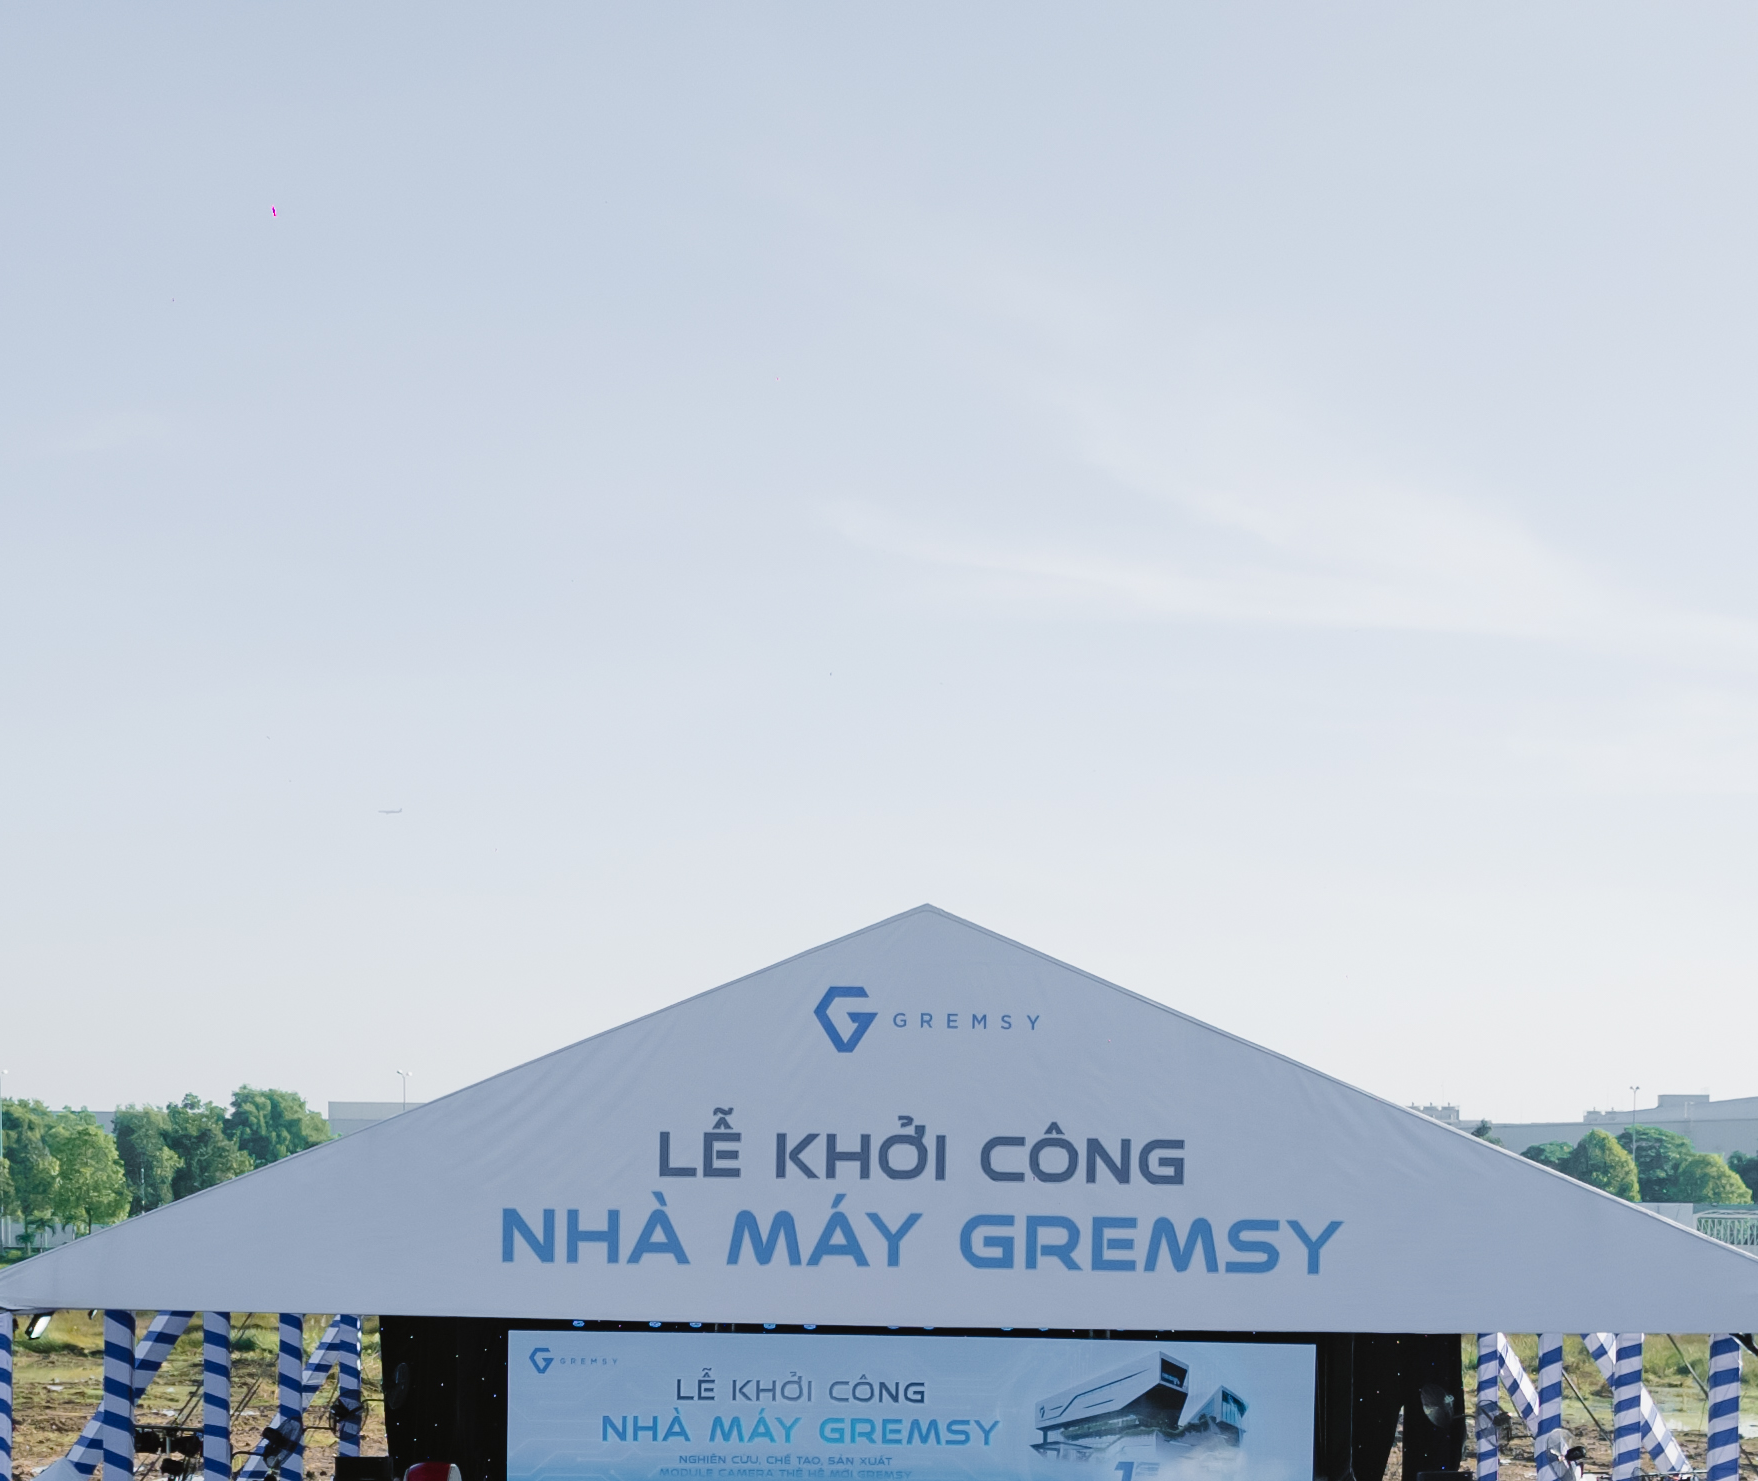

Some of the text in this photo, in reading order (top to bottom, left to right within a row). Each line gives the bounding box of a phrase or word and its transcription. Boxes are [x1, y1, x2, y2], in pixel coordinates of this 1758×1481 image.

[892, 1012, 1042, 1031] GREMSY
[658, 1107, 1186, 1187] LỄ KHỞI CÔNG
[501, 1191, 1345, 1277] NHÀ MÁY GREMSY
[559, 1357, 619, 1366] GREMSY
[675, 1367, 927, 1405] LỄ KHỞI CÔNG
[601, 1407, 1001, 1448] NHÀ MÁY GREMSY
[858, 1470, 912, 1480] GREMSY
